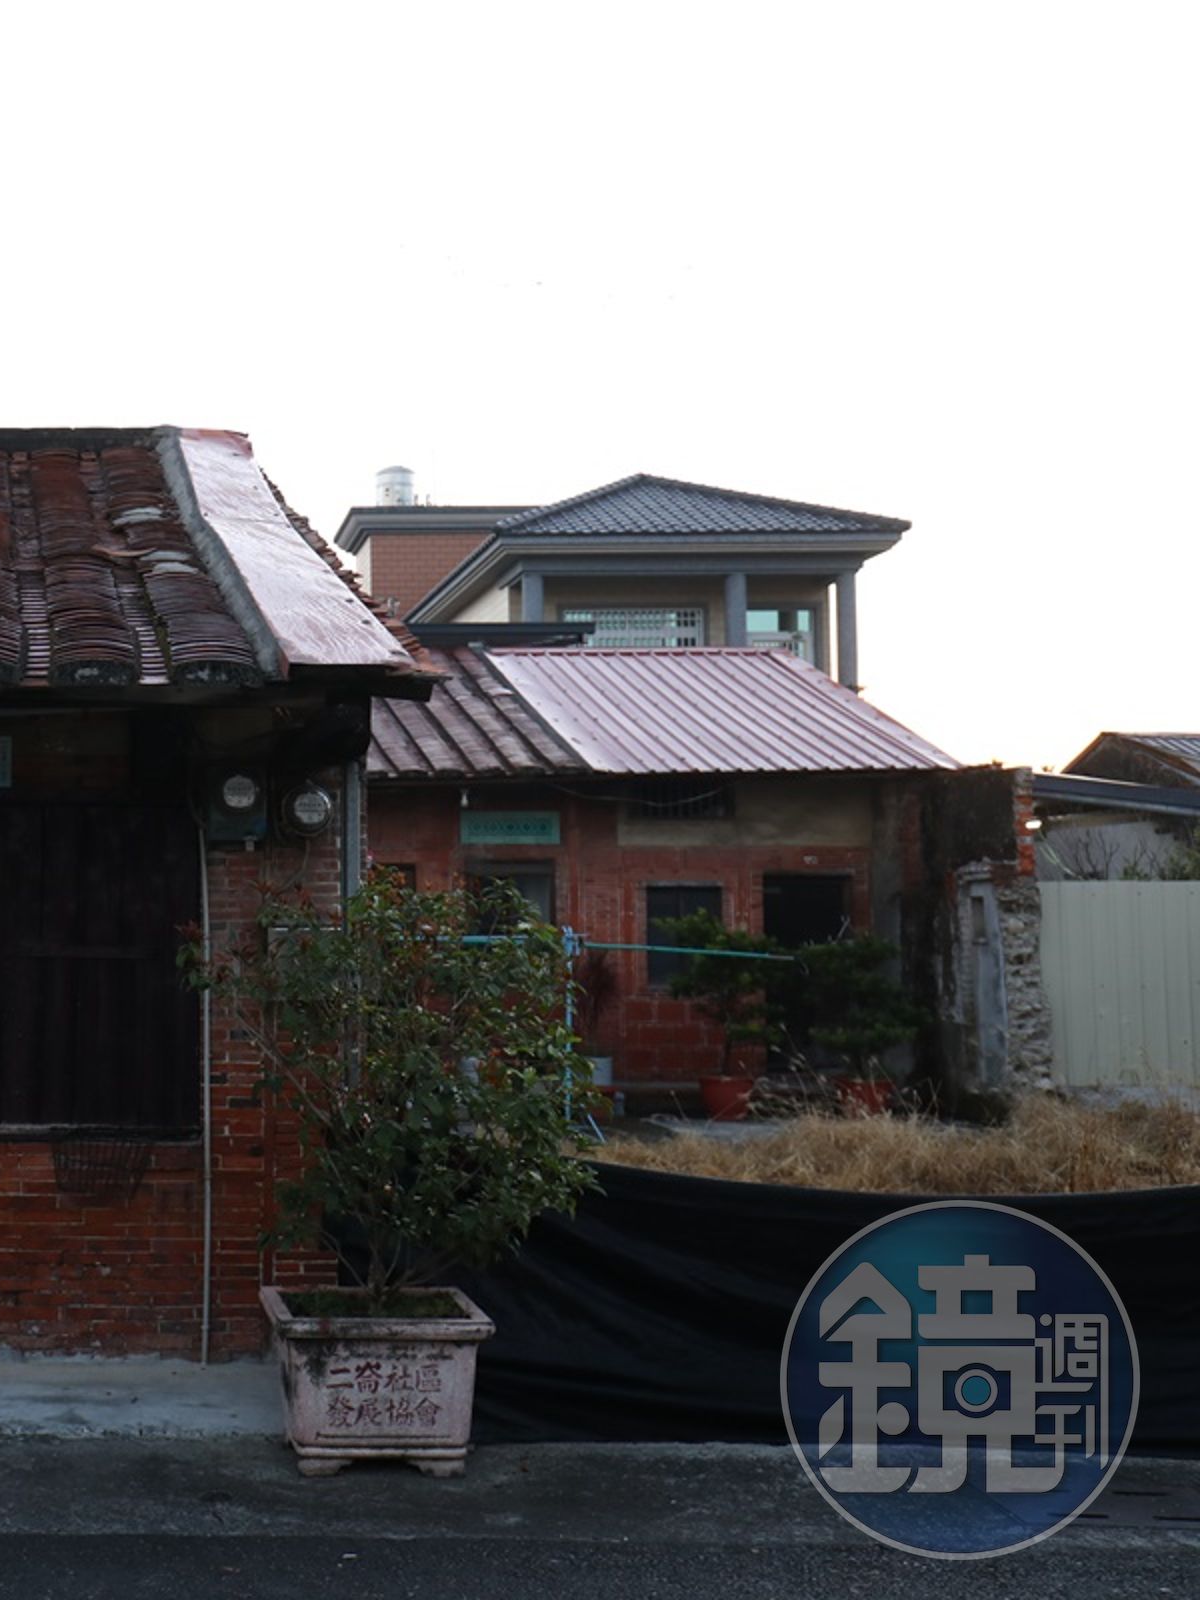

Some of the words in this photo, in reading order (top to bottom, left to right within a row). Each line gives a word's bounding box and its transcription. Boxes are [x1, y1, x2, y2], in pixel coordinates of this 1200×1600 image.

[326, 1361, 442, 1393] 二崙社區
[326, 1396, 442, 1427] 發展協會
